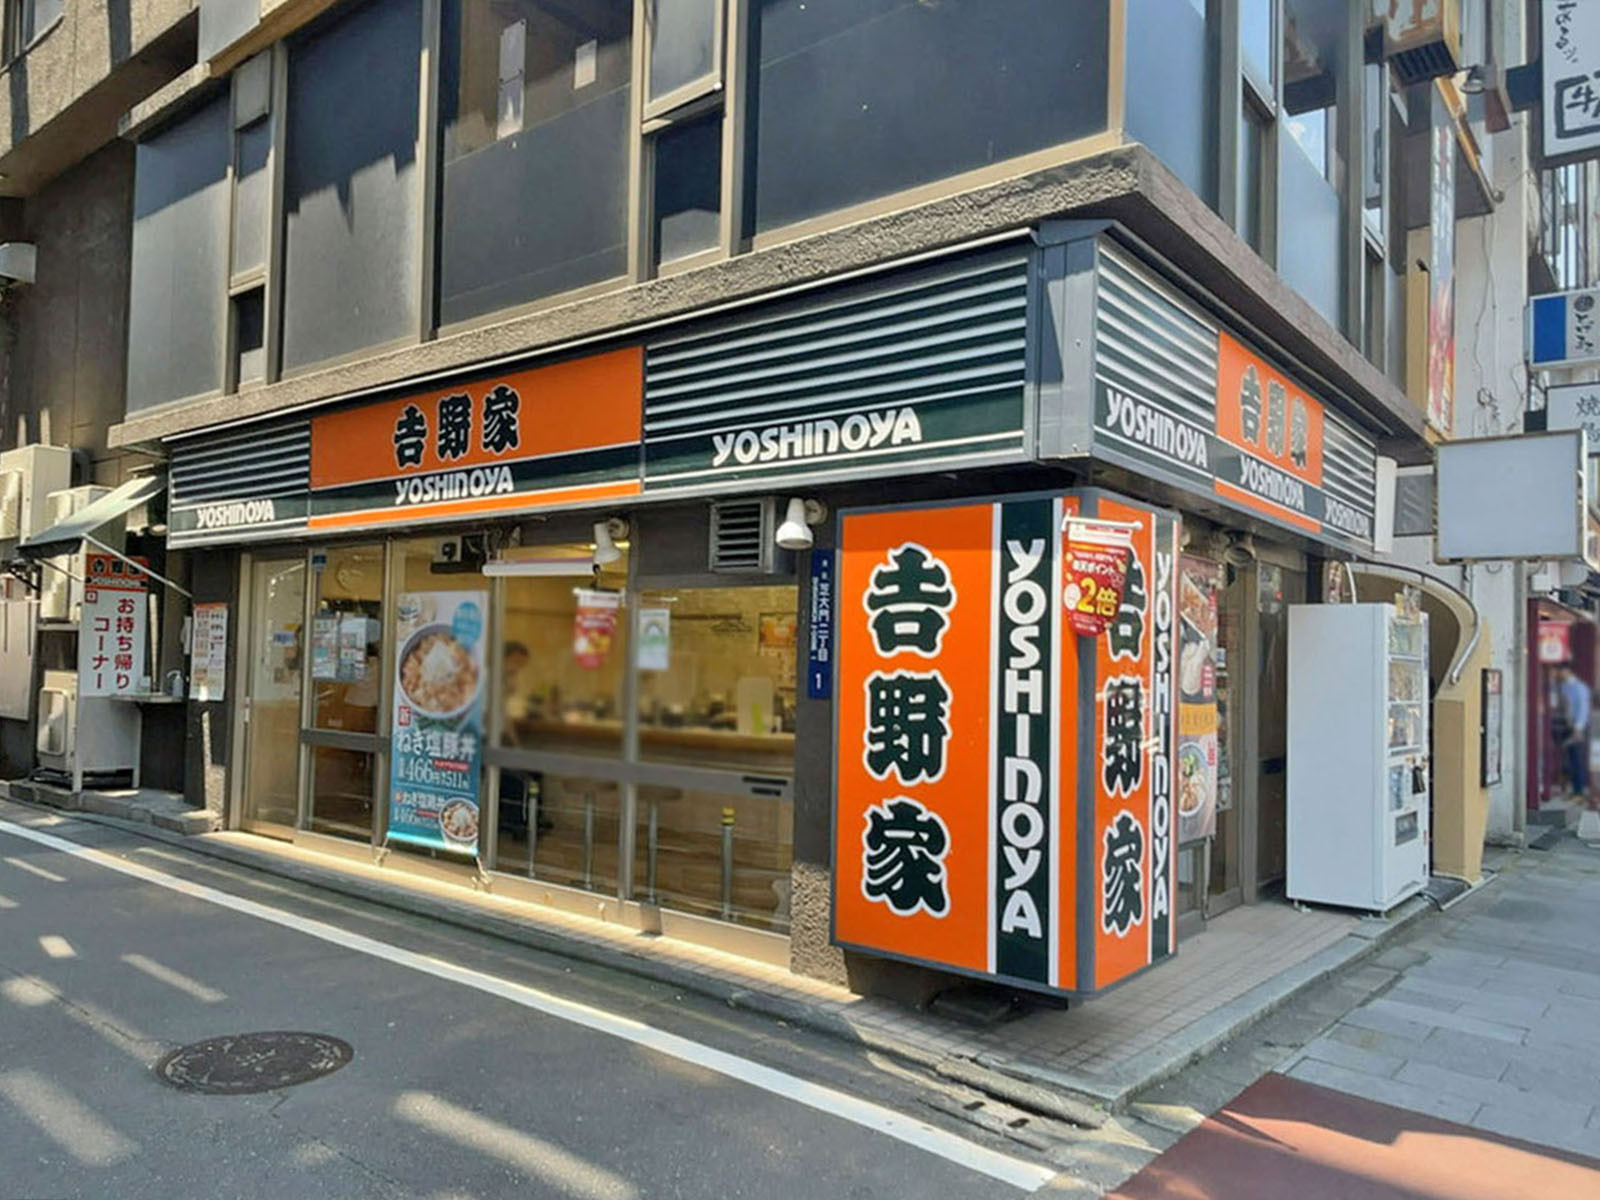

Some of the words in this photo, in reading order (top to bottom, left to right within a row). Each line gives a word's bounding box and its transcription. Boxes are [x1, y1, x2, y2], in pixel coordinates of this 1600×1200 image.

[393, 384, 520, 468] 吉野家
[712, 406, 923, 467] YOSHINOYA
[1107, 388, 1208, 469] YOSHINOYA
[1240, 364, 1308, 470] 吉野家
[196, 499, 275, 528] YOSHINOYA
[395, 466, 514, 505] YOSHINOYA
[1240, 455, 1305, 511] YOSHINOYA
[1076, 576, 1118, 617] 2倍
[92, 617, 110, 690] コーナー
[115, 598, 135, 690] お持ち帰り
[862, 542, 956, 918] 吉野家
[1002, 538, 1047, 938] YOSHINOYA
[1153, 552, 1171, 920] YOSHINOYA
